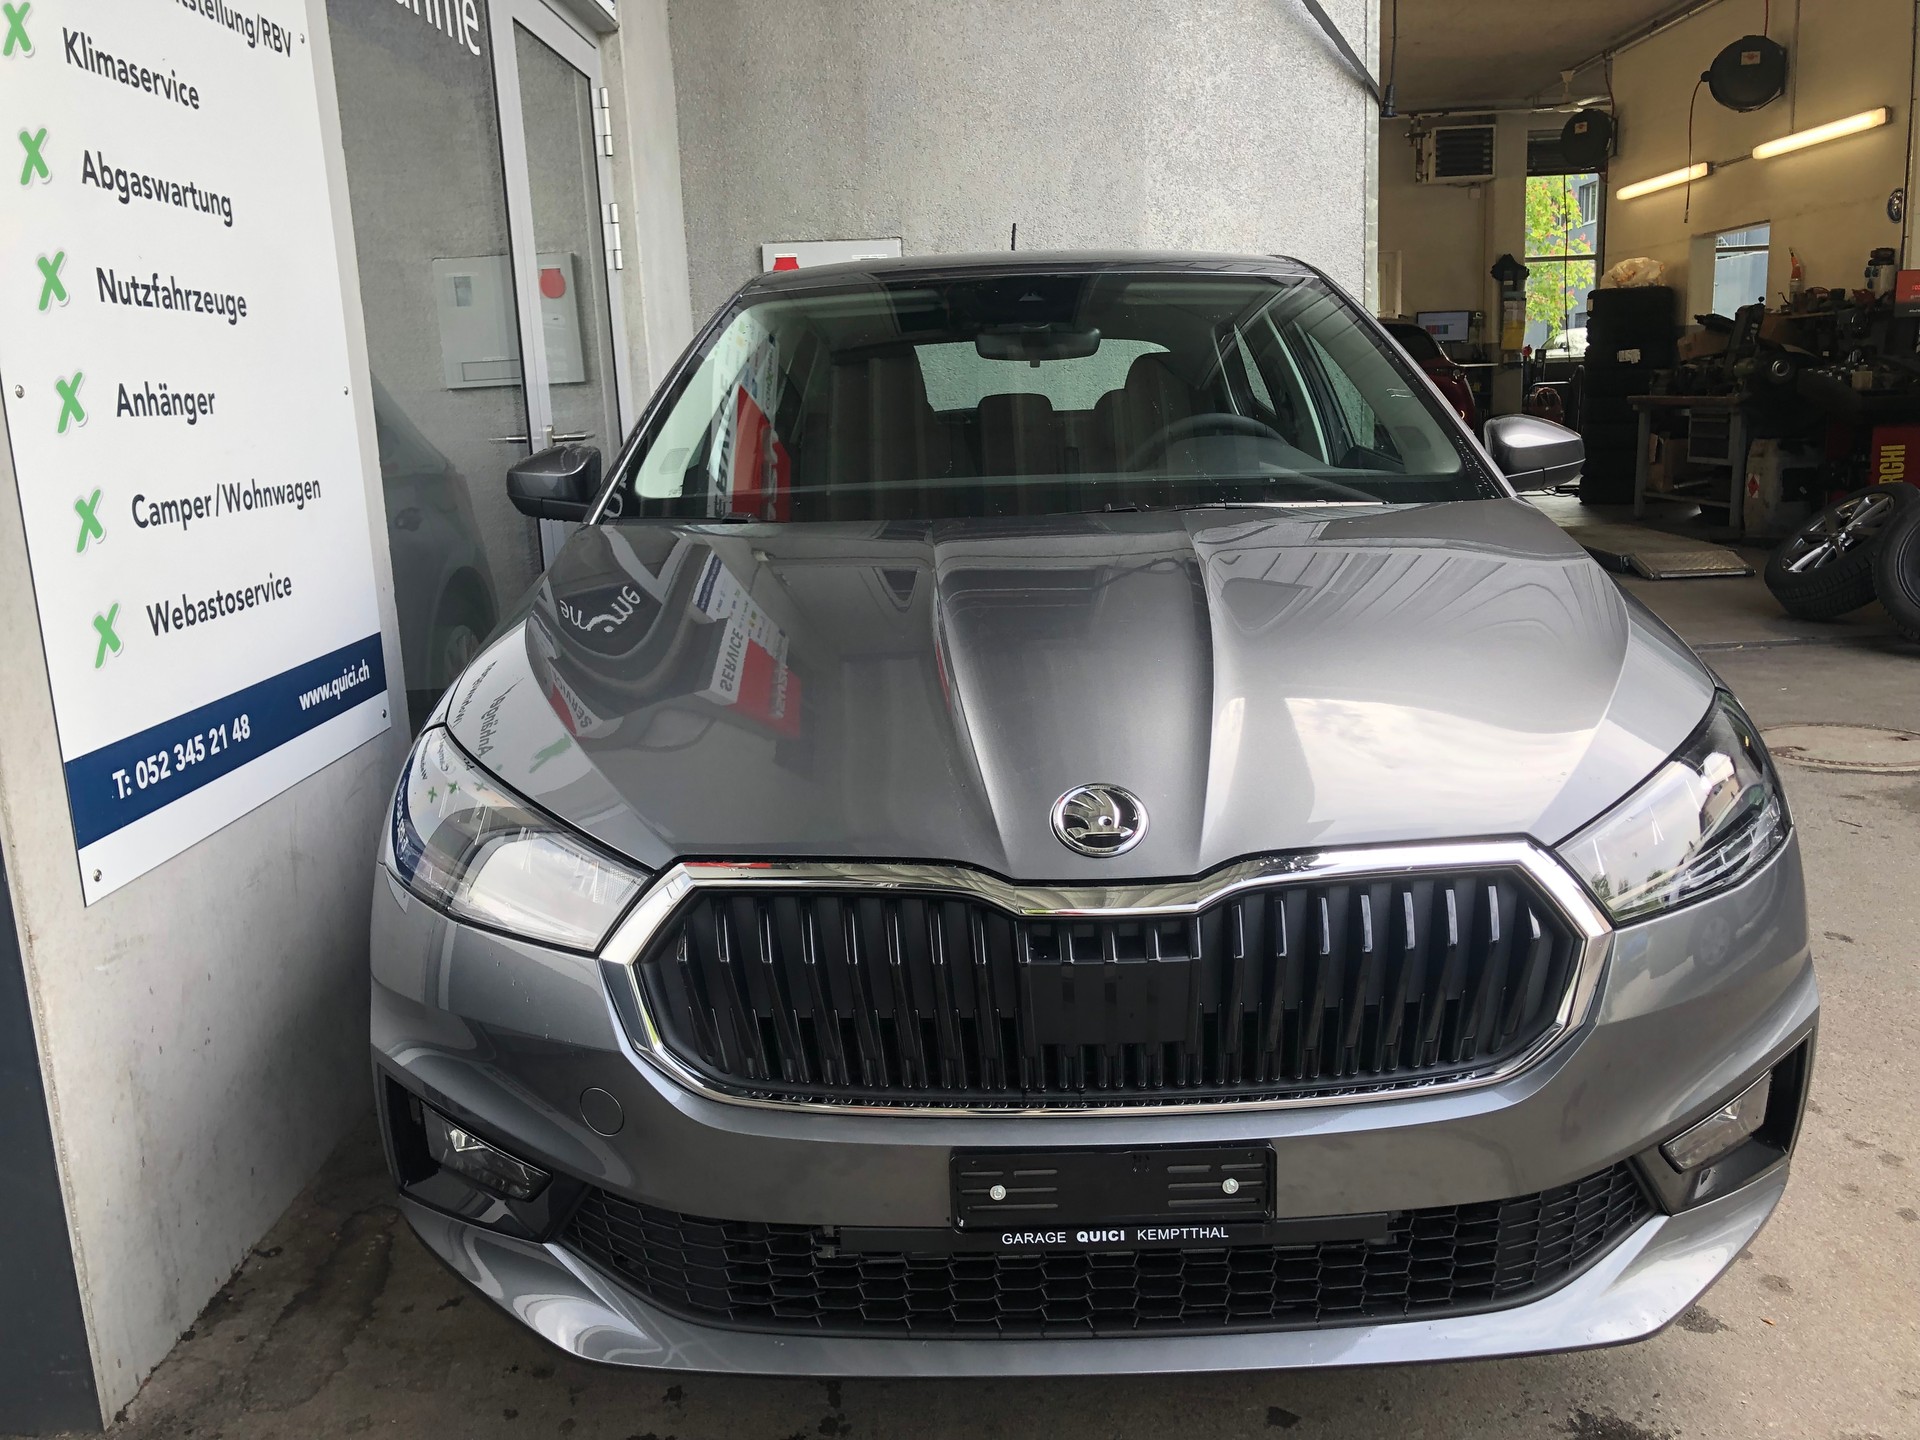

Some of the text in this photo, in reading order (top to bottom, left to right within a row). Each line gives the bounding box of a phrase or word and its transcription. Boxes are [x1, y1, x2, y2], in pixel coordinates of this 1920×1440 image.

[176, 0, 291, 57] stellung/RBV
[62, 27, 200, 109] Klimaservice
[82, 149, 233, 227] Abgaswartung
[96, 267, 247, 325] Nutzfahrzeuge
[116, 381, 215, 425] Anhänger
[146, 572, 292, 636] Webastoservice
[299, 660, 370, 711] www.quici.ch
[112, 713, 251, 800] T: 052 345 21 48
[1001, 1225, 1229, 1245] GARAGE QUICI KEMPTTHAL
